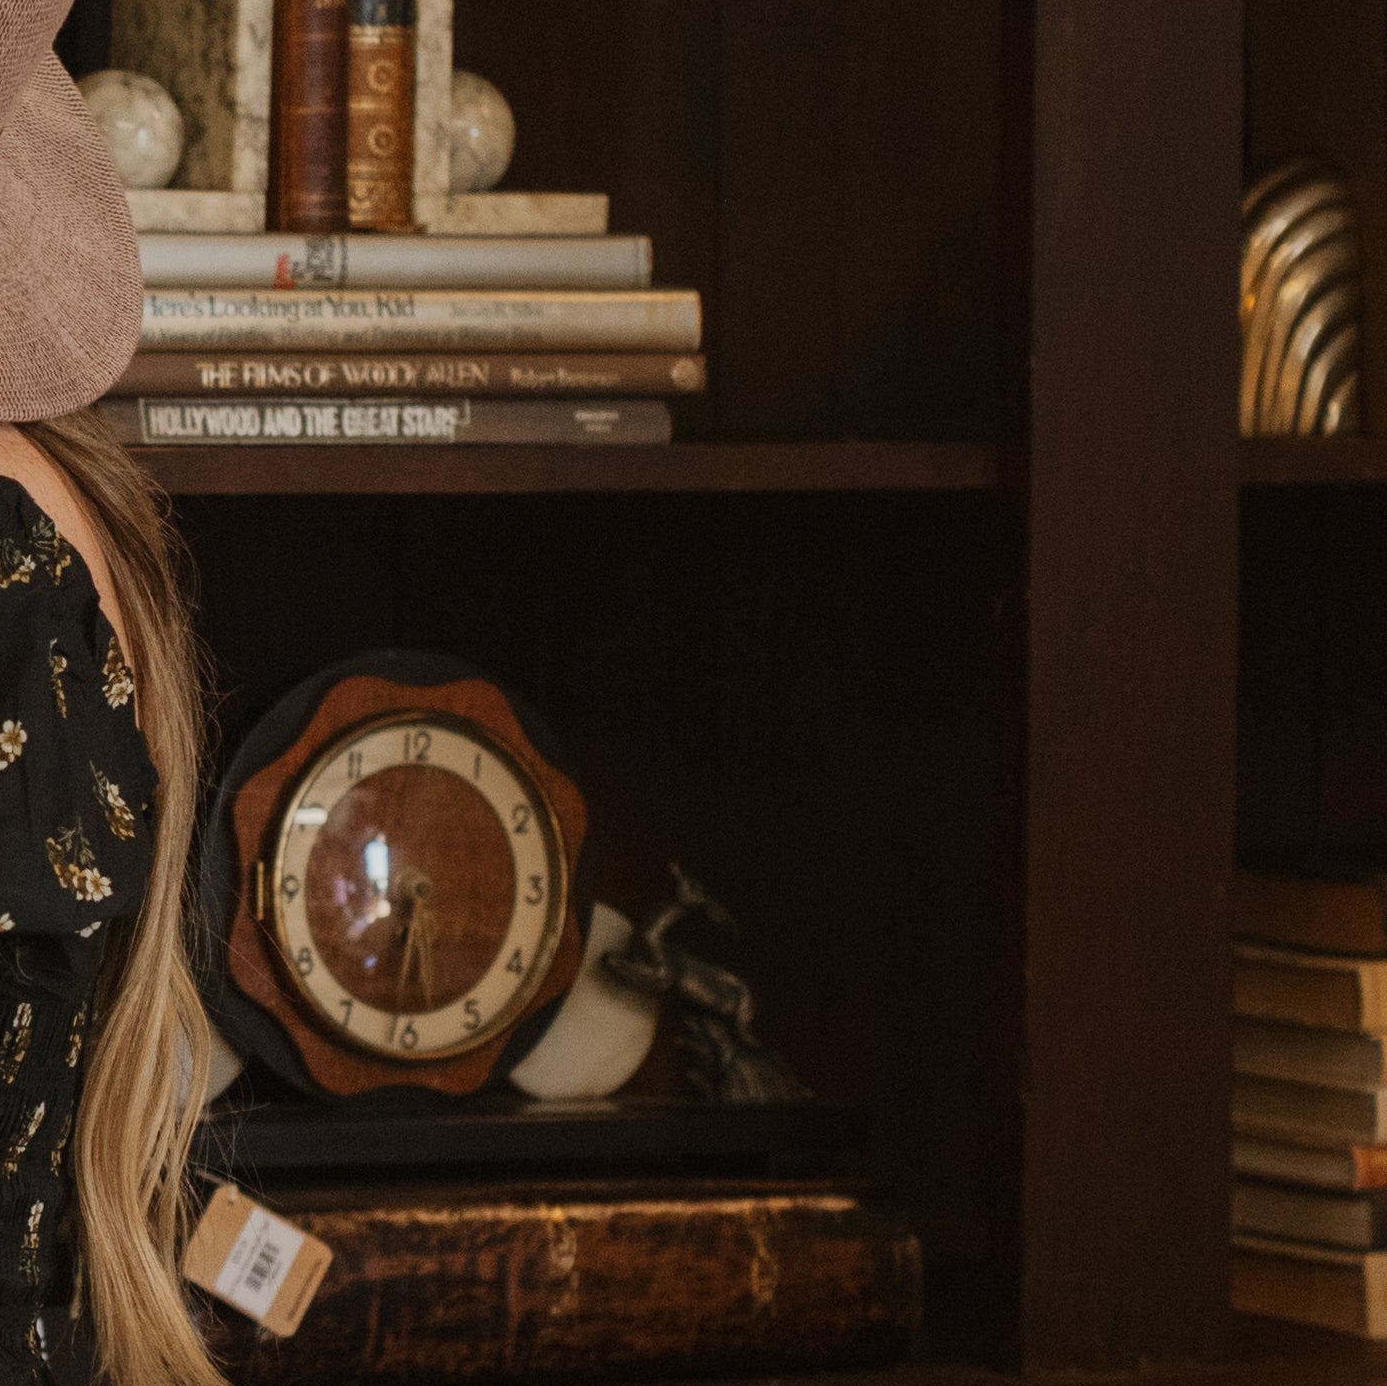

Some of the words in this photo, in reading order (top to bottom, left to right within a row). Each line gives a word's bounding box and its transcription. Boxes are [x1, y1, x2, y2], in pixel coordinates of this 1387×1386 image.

[208, 293, 300, 323] Looking
[377, 294, 414, 317] Kid
[196, 362, 238, 388] THE
[243, 362, 302, 388] FILMS
[303, 362, 334, 388] OF
[341, 363, 421, 388] WOODY
[426, 363, 489, 388] ALLEN
[149, 406, 260, 437] HOLLYWOOD
[263, 406, 302, 437] AND
[304, 406, 340, 437] THE
[342, 406, 399, 437] GREAT
[402, 406, 457, 438] STARS
[403, 731, 432, 762] 12
[348, 751, 362, 779] 11
[475, 753, 482, 779] 1
[512, 803, 532, 834] 2
[281, 875, 300, 903] 9
[526, 875, 543, 905] 3
[297, 947, 313, 976] 8
[506, 948, 523, 976] 4
[340, 999, 353, 1029] 7
[464, 999, 481, 1031] 5
[400, 1021, 419, 1049] 6
